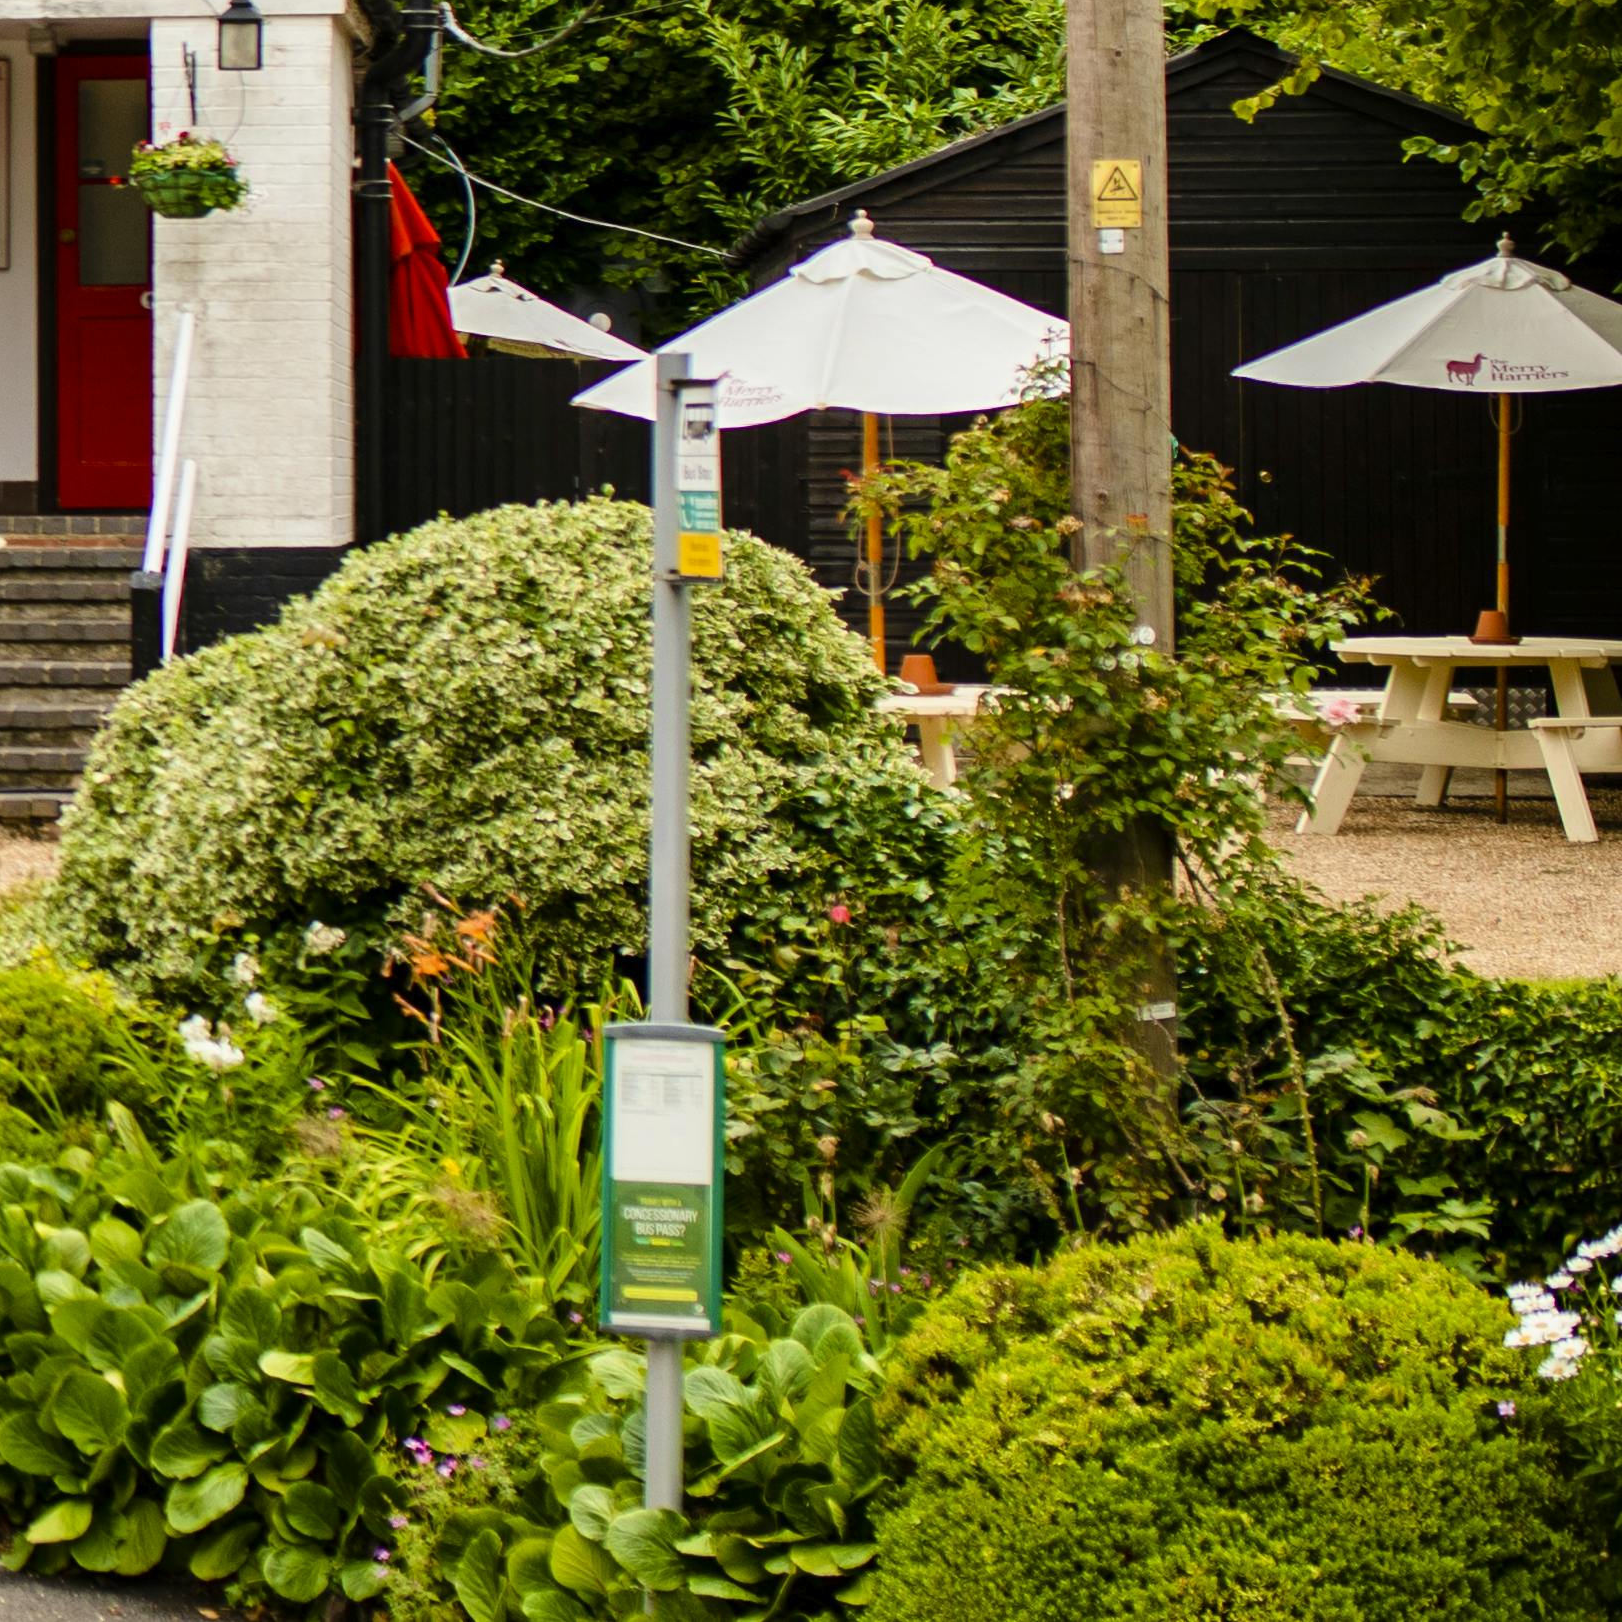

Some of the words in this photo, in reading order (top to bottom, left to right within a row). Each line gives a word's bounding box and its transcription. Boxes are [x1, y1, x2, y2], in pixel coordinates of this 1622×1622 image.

[1491, 364, 1548, 374] Merry
[1491, 371, 1569, 382] Harriers
[623, 1207, 698, 1224] CONCESSIONARY
[636, 1222, 655, 1236] BUS
